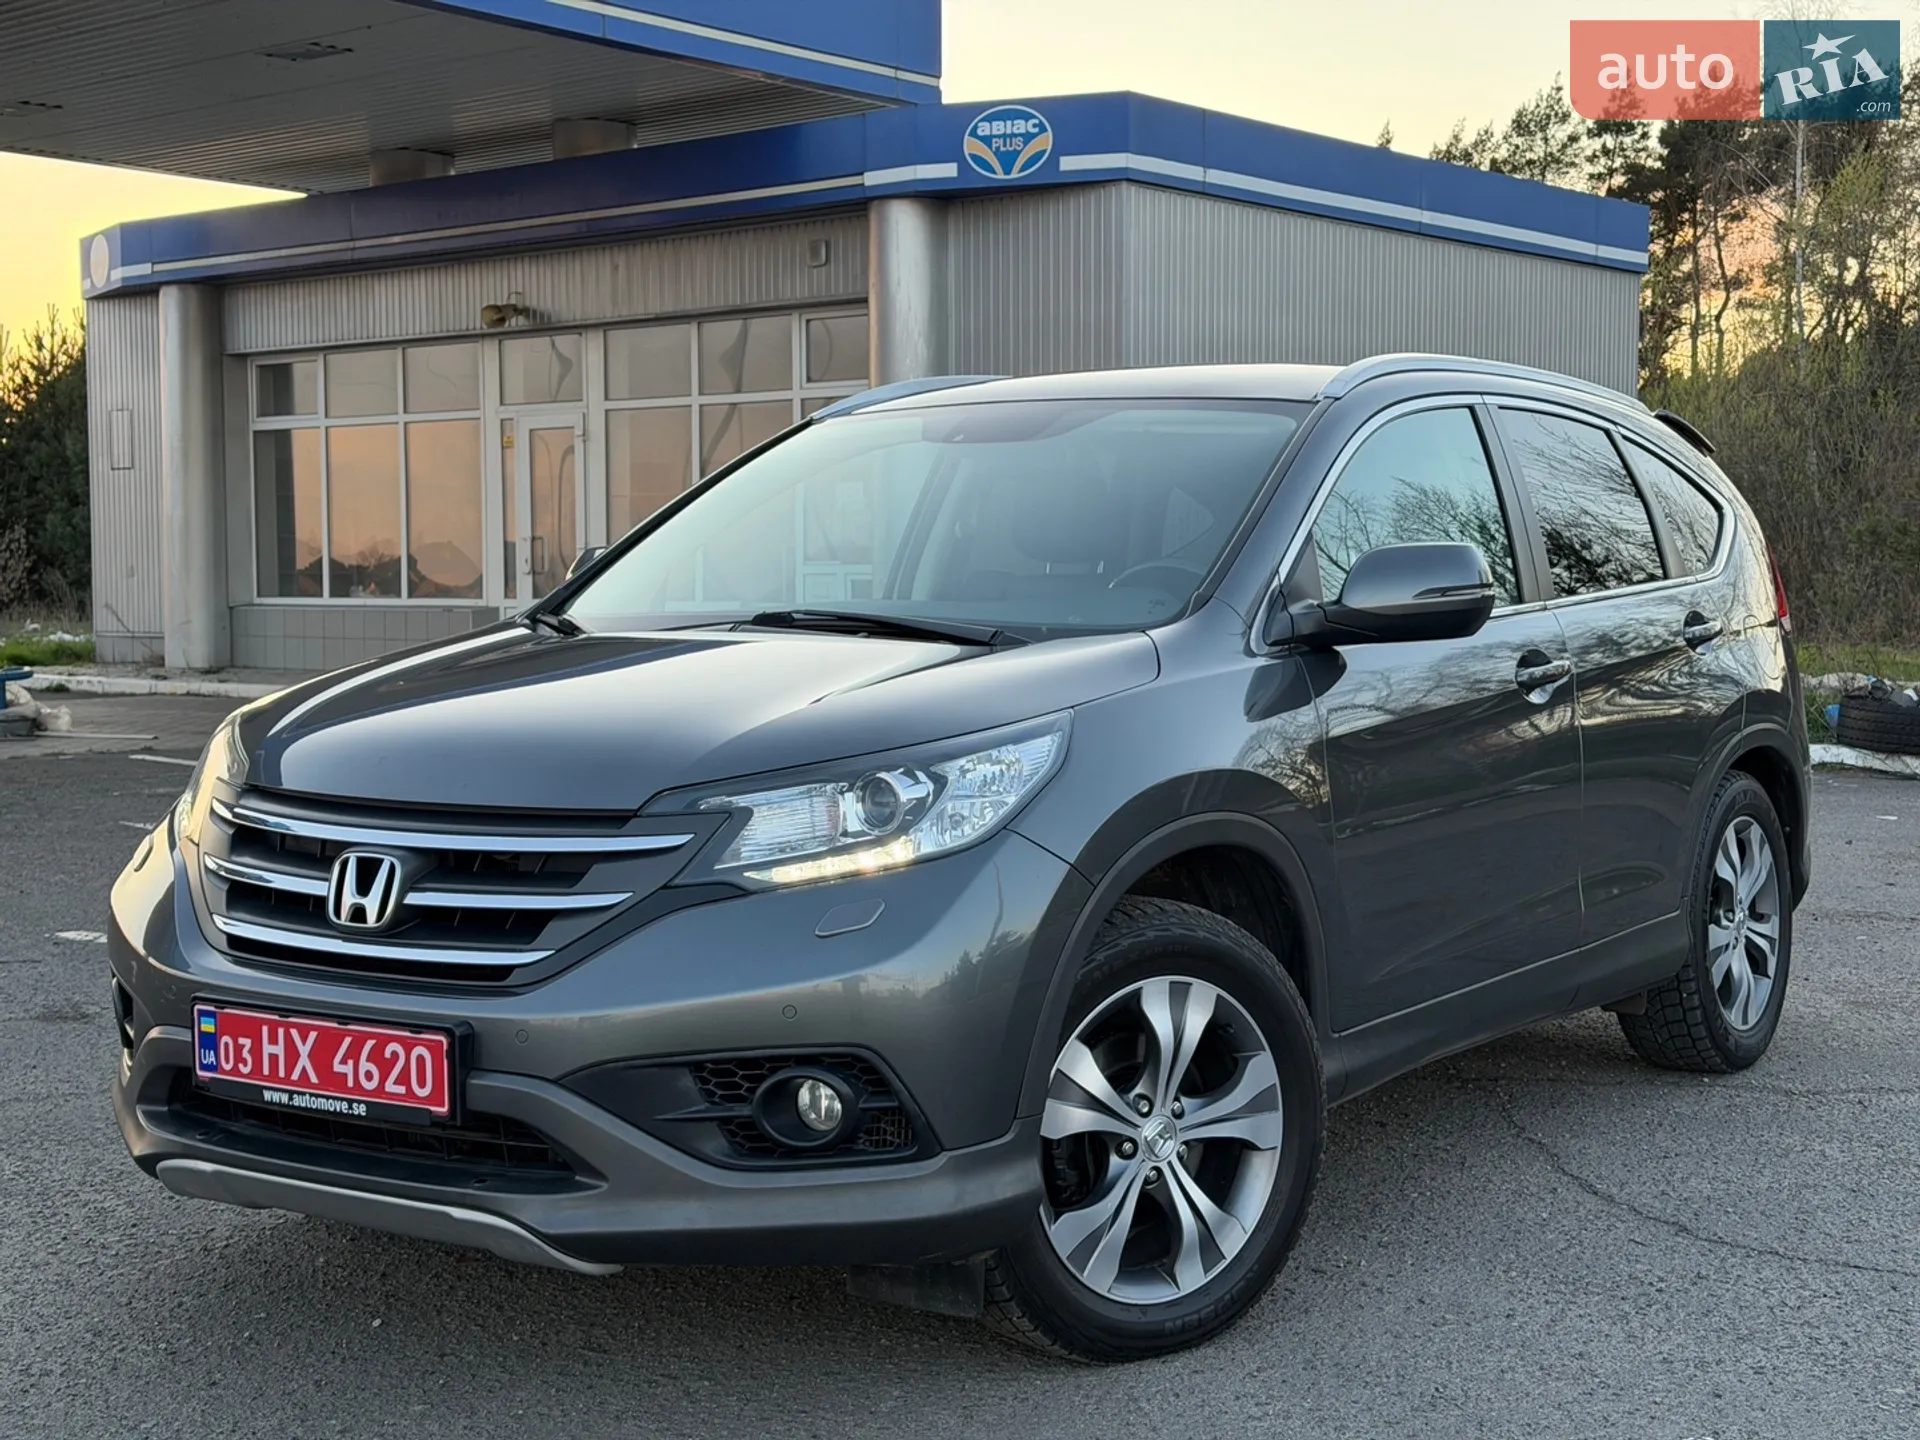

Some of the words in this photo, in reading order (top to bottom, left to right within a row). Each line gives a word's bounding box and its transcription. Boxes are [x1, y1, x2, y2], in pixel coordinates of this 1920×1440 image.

[992, 136, 1024, 152] PLUS
[201, 1048, 216, 1066] UA
[333, 1036, 433, 1097] 4620
[262, 1087, 367, 1116] www.automove.se
